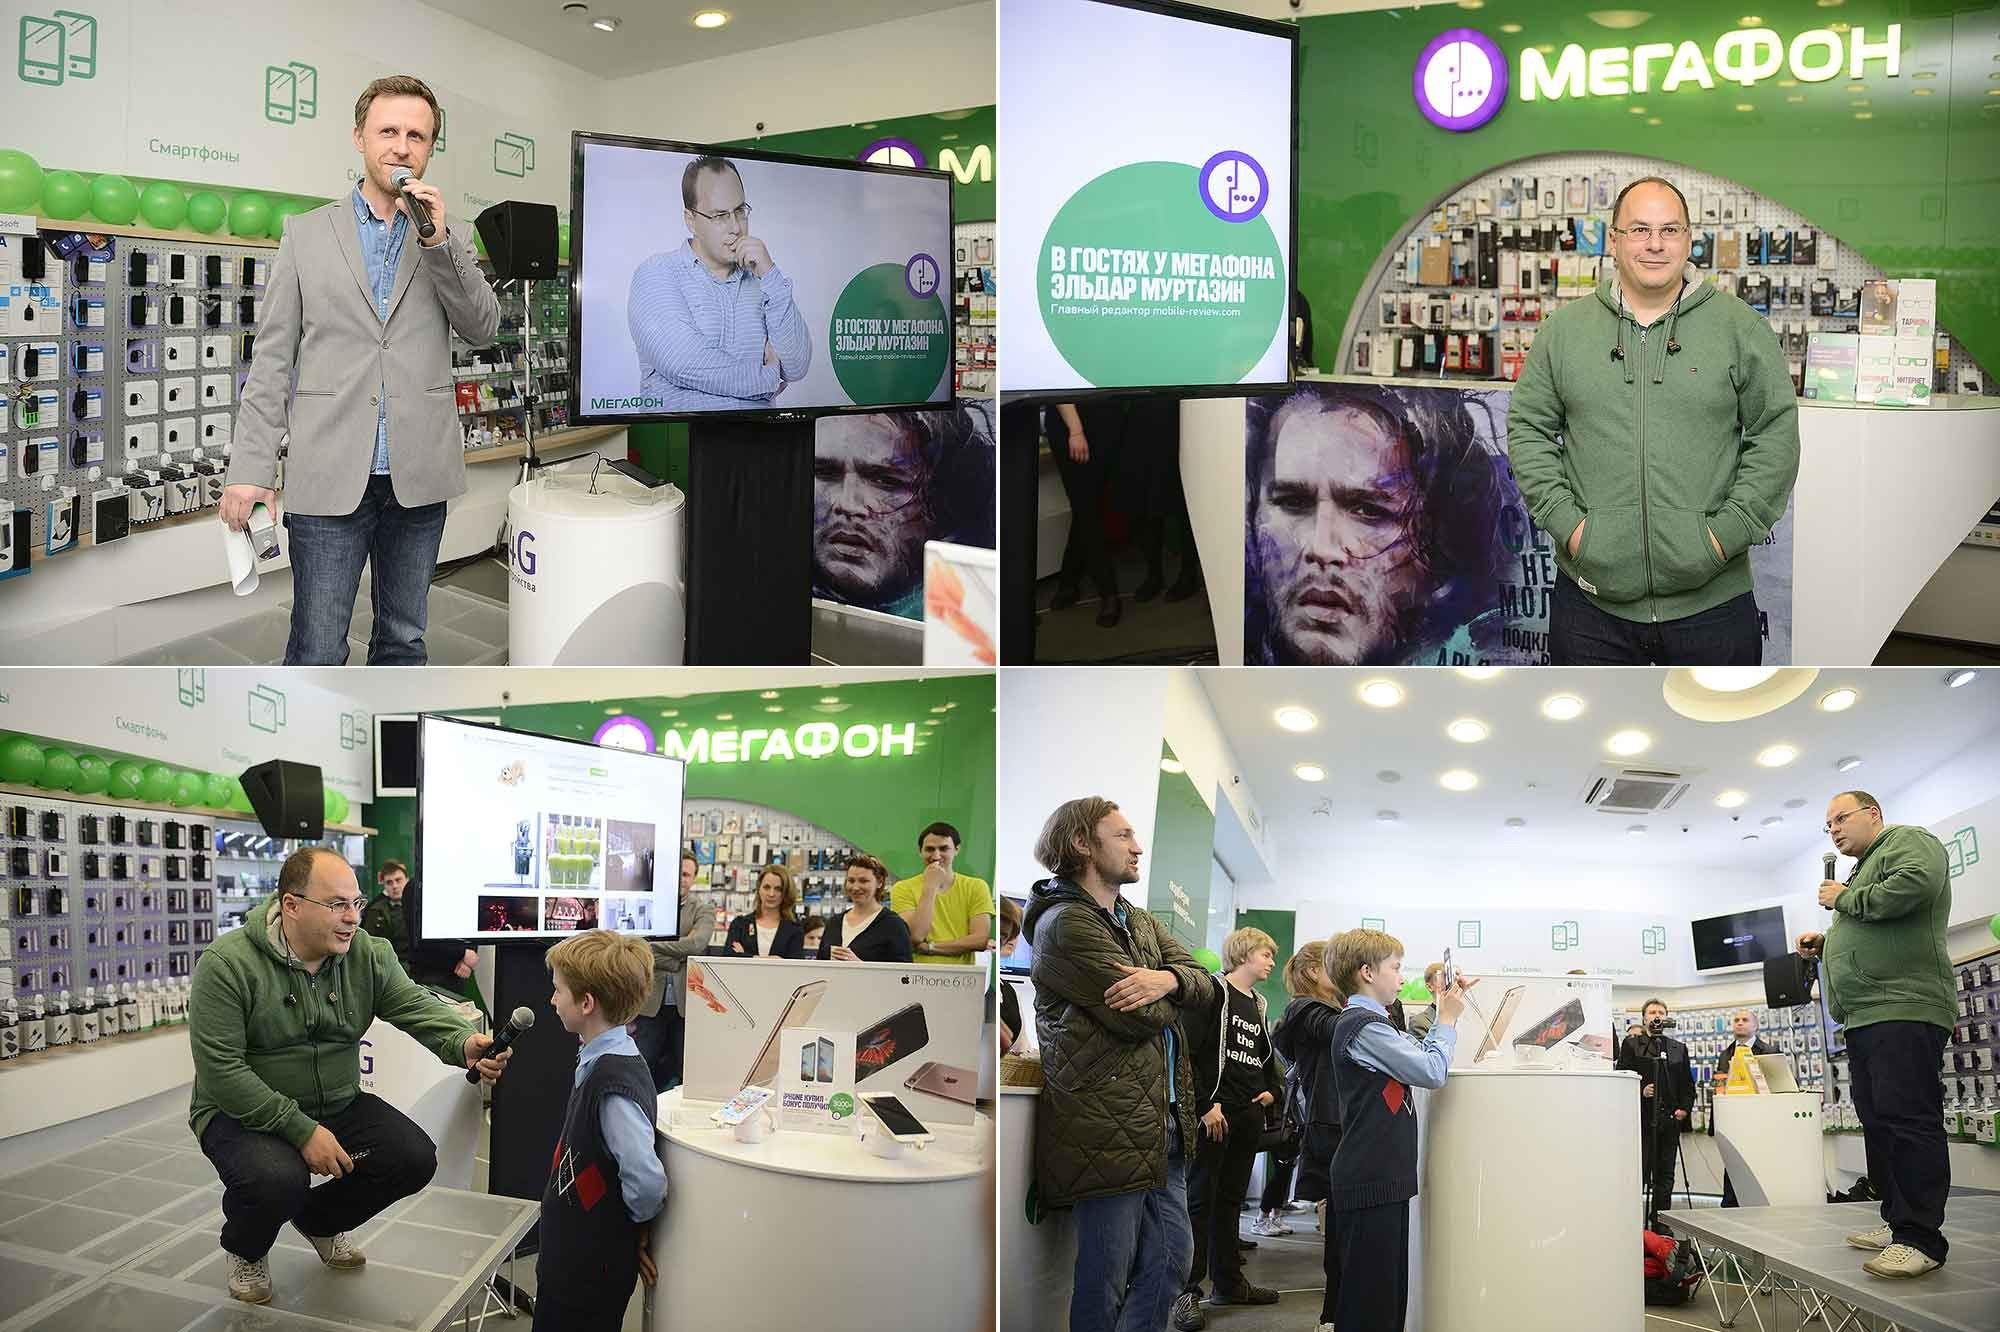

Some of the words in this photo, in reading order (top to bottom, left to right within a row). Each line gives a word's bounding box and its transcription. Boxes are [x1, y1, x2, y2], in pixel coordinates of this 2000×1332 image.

[149, 138, 240, 162] Смартфоны
[1051, 246, 1066, 272] В
[1071, 247, 1149, 274] ГОСТЯХ
[1154, 251, 1167, 275] У
[1171, 253, 1276, 280] МЕГАФОНА
[1051, 273, 1137, 301] ЭЛЬДАР
[1141, 277, 1246, 304] МУРТАЗИН
[1051, 304, 1099, 316] Главный
[1101, 306, 1151, 318] редактор
[1153, 307, 1241, 317] mobile-review.com
[835, 319, 843, 334] В
[844, 319, 881, 334] ГОСТЯХ
[883, 320, 890, 334] У
[892, 320, 944, 334] МЕГАФОНА
[836, 336, 876, 351] ЭЛЬДАР
[878, 336, 929, 350] МУРТАЗИН
[1522, 552, 1555, 587] НЕ
[1500, 584, 1553, 619] МОЛ
[1503, 627, 1549, 653] ПОДКЛ
[115, 715, 168, 742] Смартфоны
[912, 975, 951, 987] iPhone
[953, 976, 960, 987] 6
[1236, 1032, 1255, 1049] the
